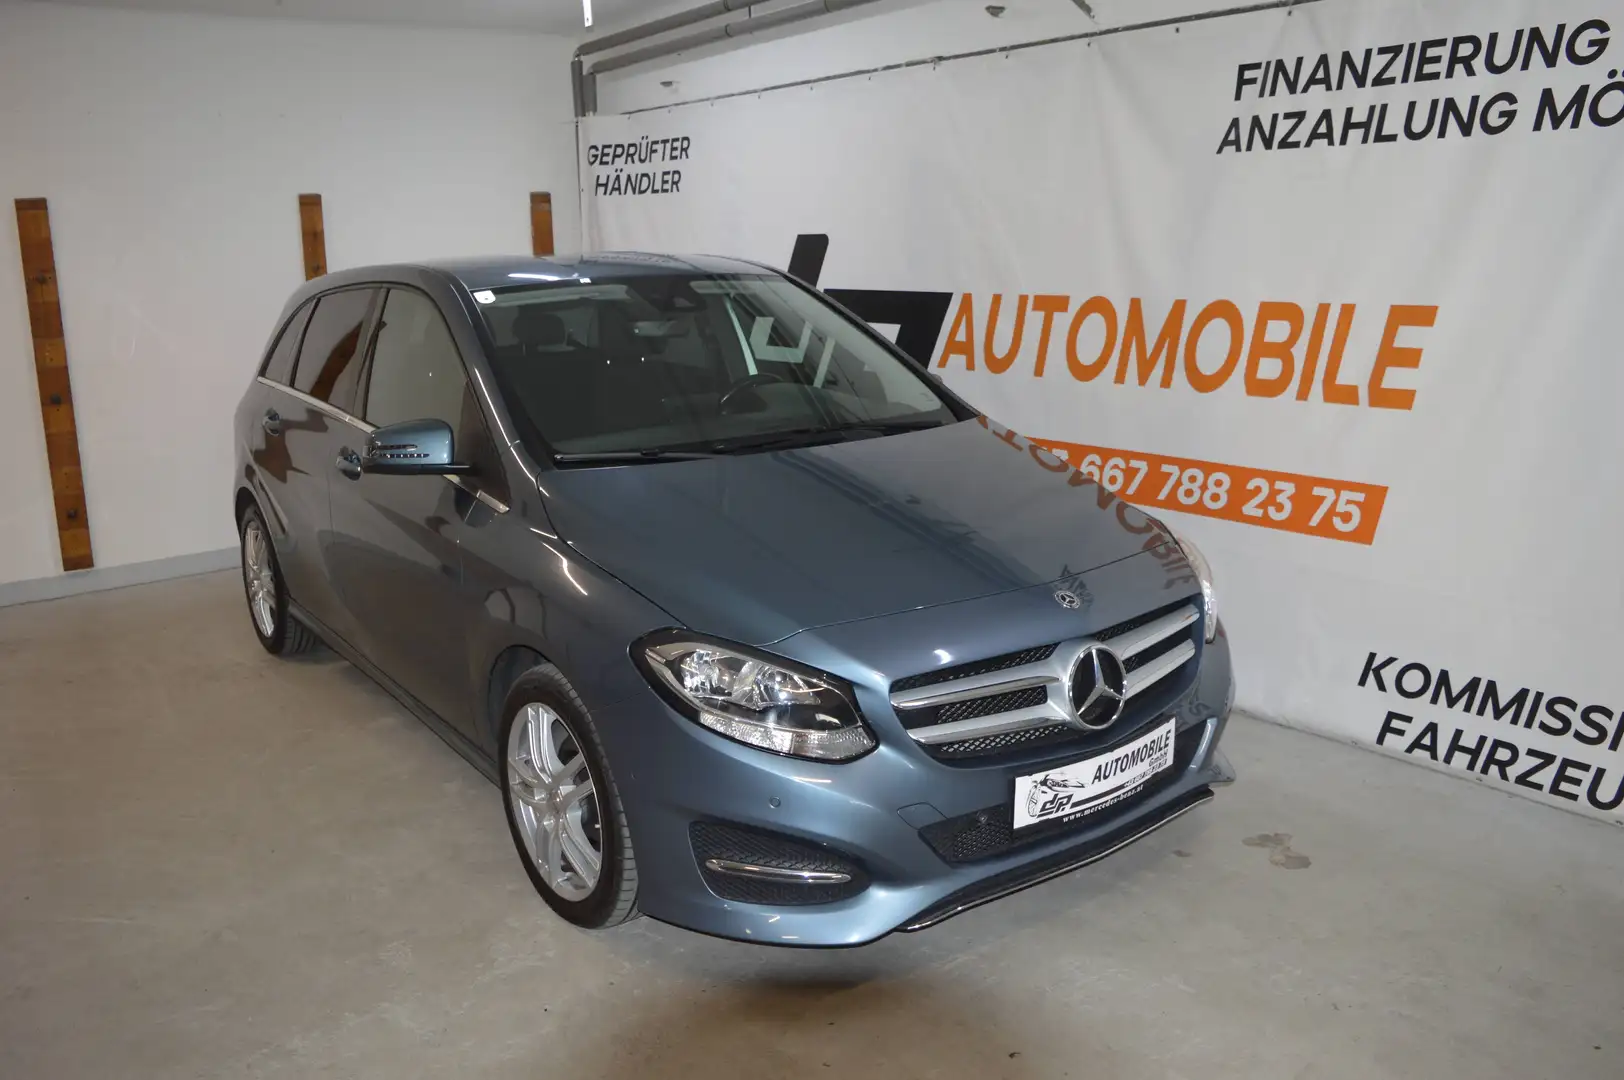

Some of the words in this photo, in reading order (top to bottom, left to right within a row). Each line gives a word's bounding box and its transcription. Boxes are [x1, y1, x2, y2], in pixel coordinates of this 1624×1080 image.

[1234, 19, 1611, 101] FINANZIERUNG
[587, 135, 691, 167] GEPRÜFTER
[1216, 91, 1518, 155] ANZAHLUNG
[594, 168, 681, 197] HÄNDLER
[937, 292, 1439, 411] AUTOMOBILE
[1079, 453, 1149, 496] 667
[1157, 464, 1231, 510] 788
[1241, 477, 1296, 521] 23
[1309, 490, 1367, 534] 75
[1091, 729, 1172, 785] AUTOMOBILE
[1375, 710, 1624, 811] FAHRZEU
